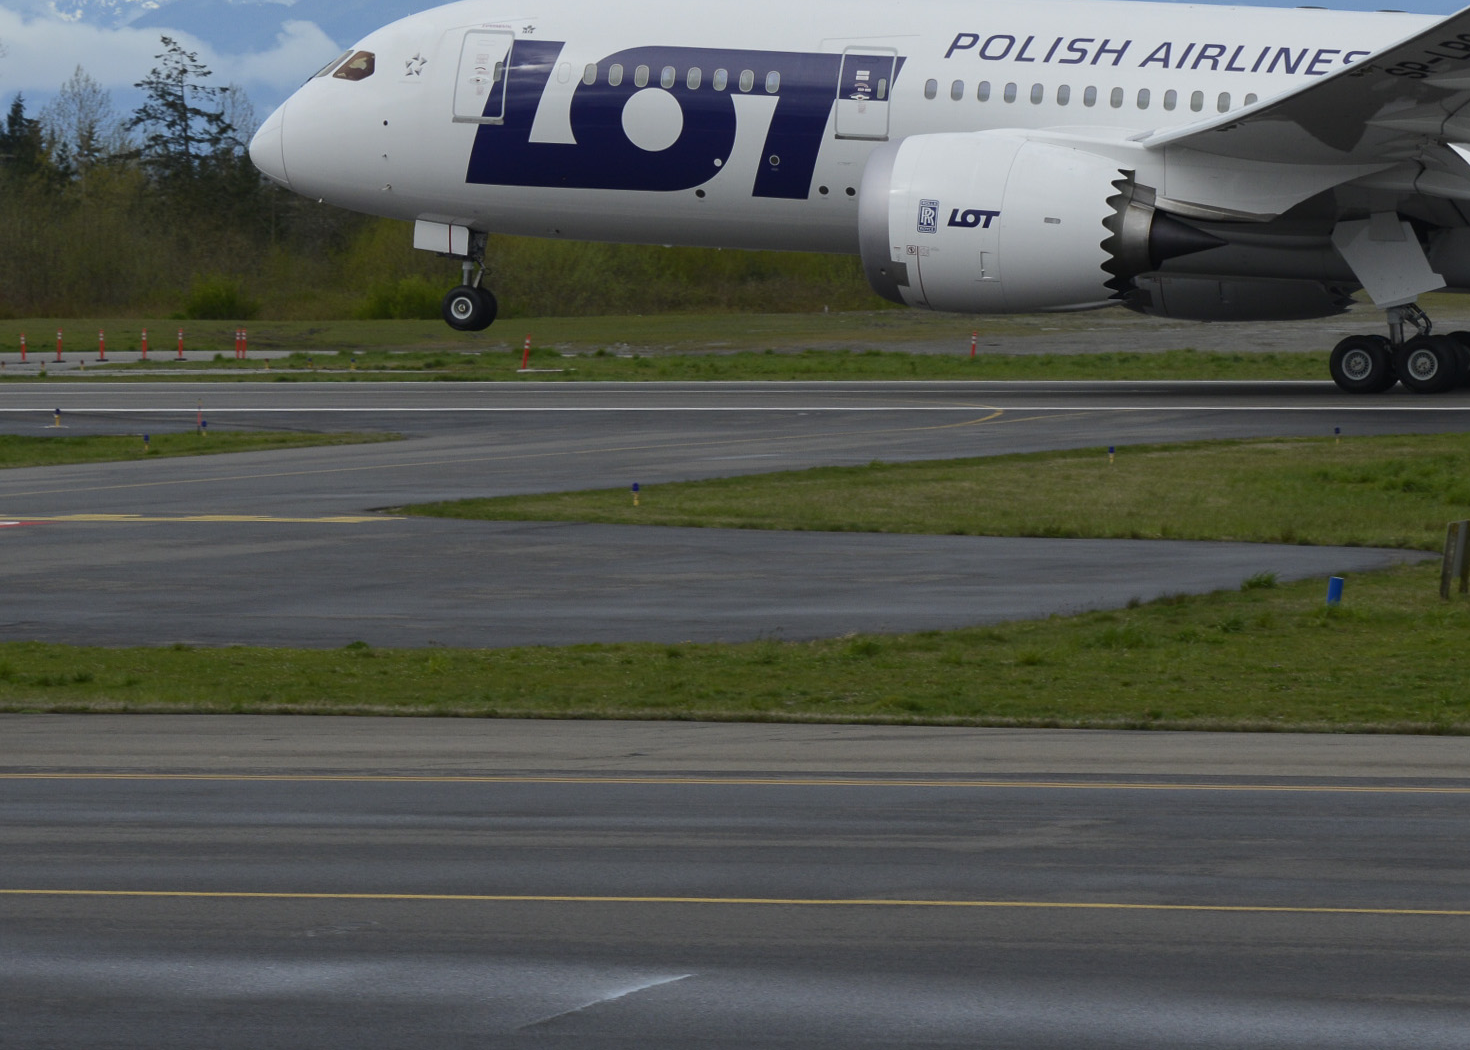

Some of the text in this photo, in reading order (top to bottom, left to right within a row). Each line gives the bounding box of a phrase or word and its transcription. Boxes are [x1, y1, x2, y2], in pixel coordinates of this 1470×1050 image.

[944, 32, 1131, 67] POLISH
[465, 39, 907, 199] LOT
[947, 208, 1001, 229] LOT
